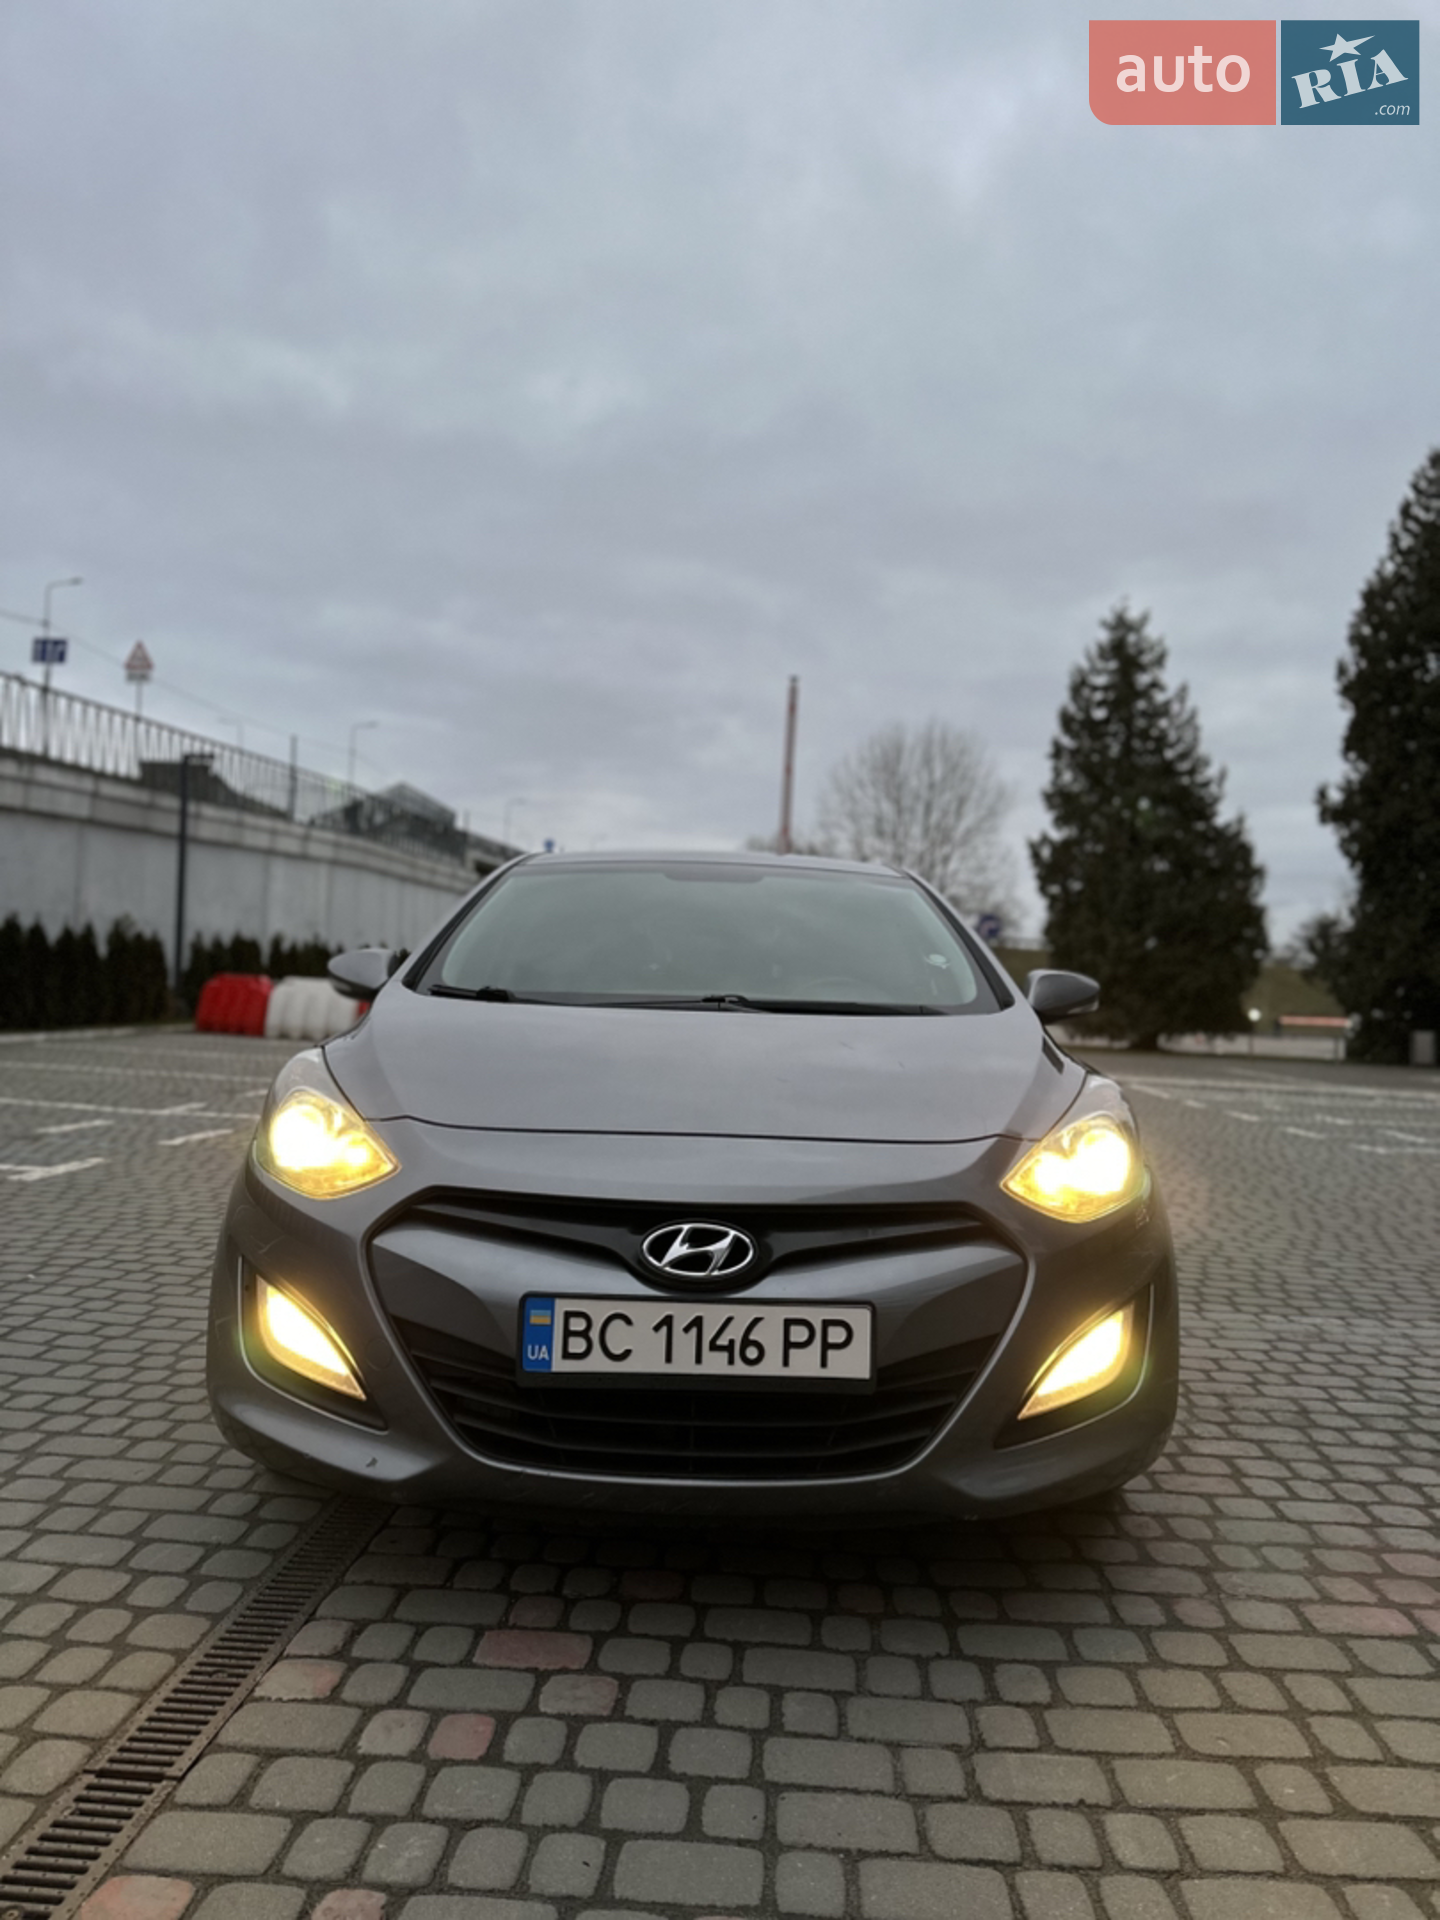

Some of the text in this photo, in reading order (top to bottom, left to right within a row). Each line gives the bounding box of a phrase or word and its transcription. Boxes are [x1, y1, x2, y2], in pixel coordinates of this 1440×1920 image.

[527, 1344, 550, 1362] UA
[560, 1309, 854, 1369] BC 1146 PP
